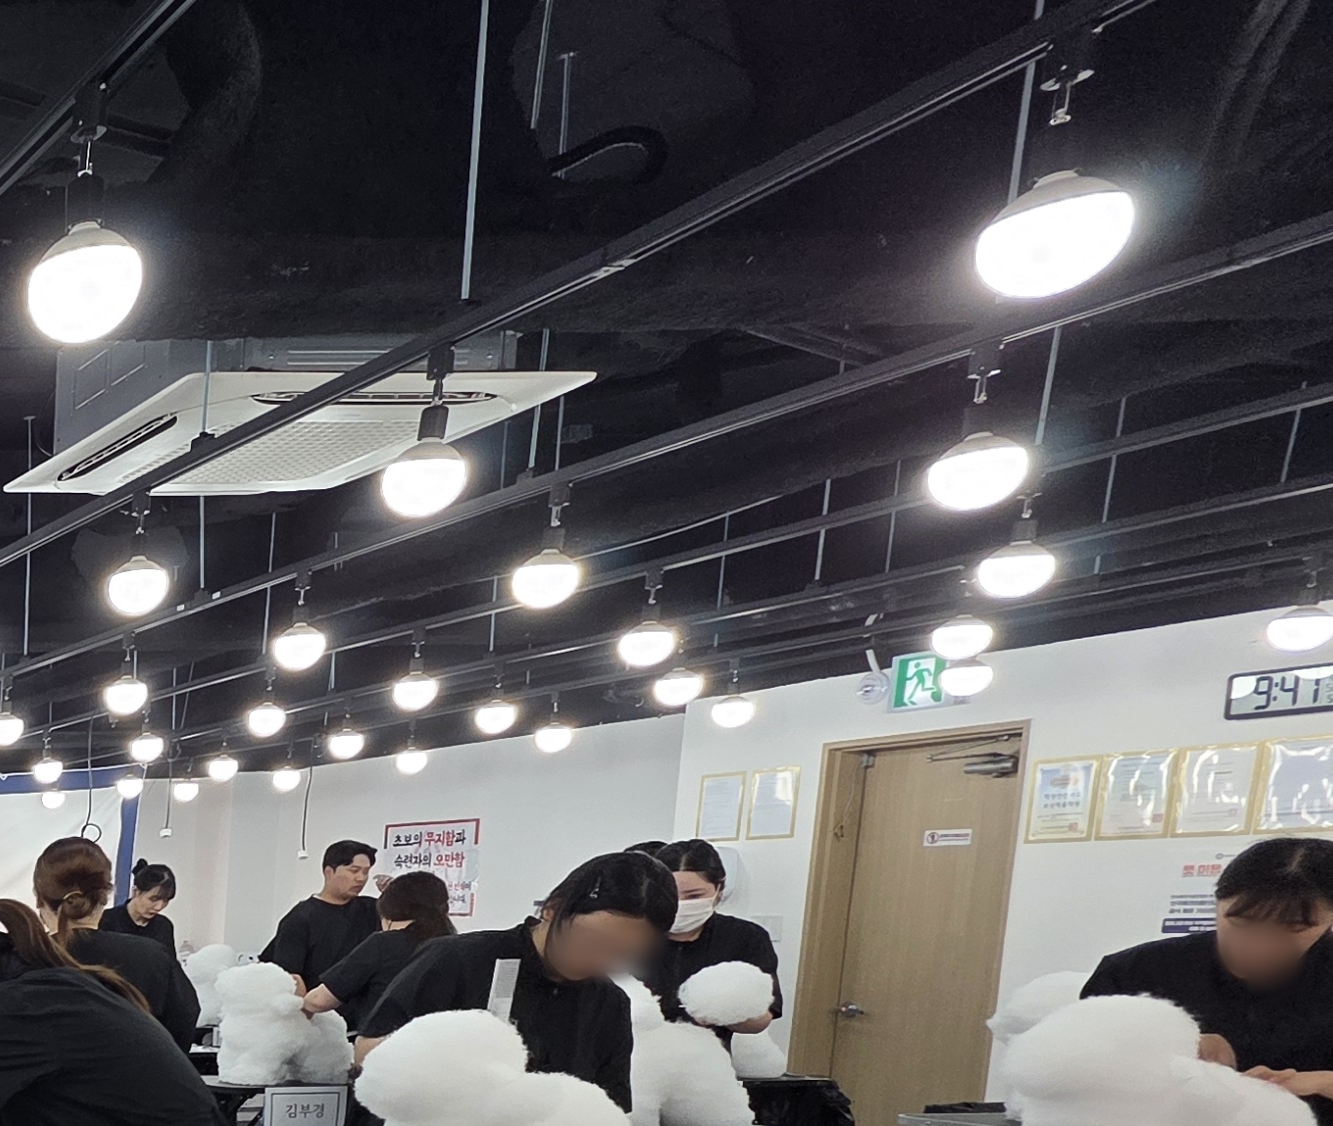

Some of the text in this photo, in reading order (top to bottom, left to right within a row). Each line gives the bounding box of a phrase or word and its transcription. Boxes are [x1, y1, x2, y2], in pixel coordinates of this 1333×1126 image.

[1253, 675, 1320, 709] 9:41
[424, 829, 466, 847] 무지함과
[394, 851, 465, 869] 숙련자의 오만함
[285, 1102, 325, 1119] 김부경
